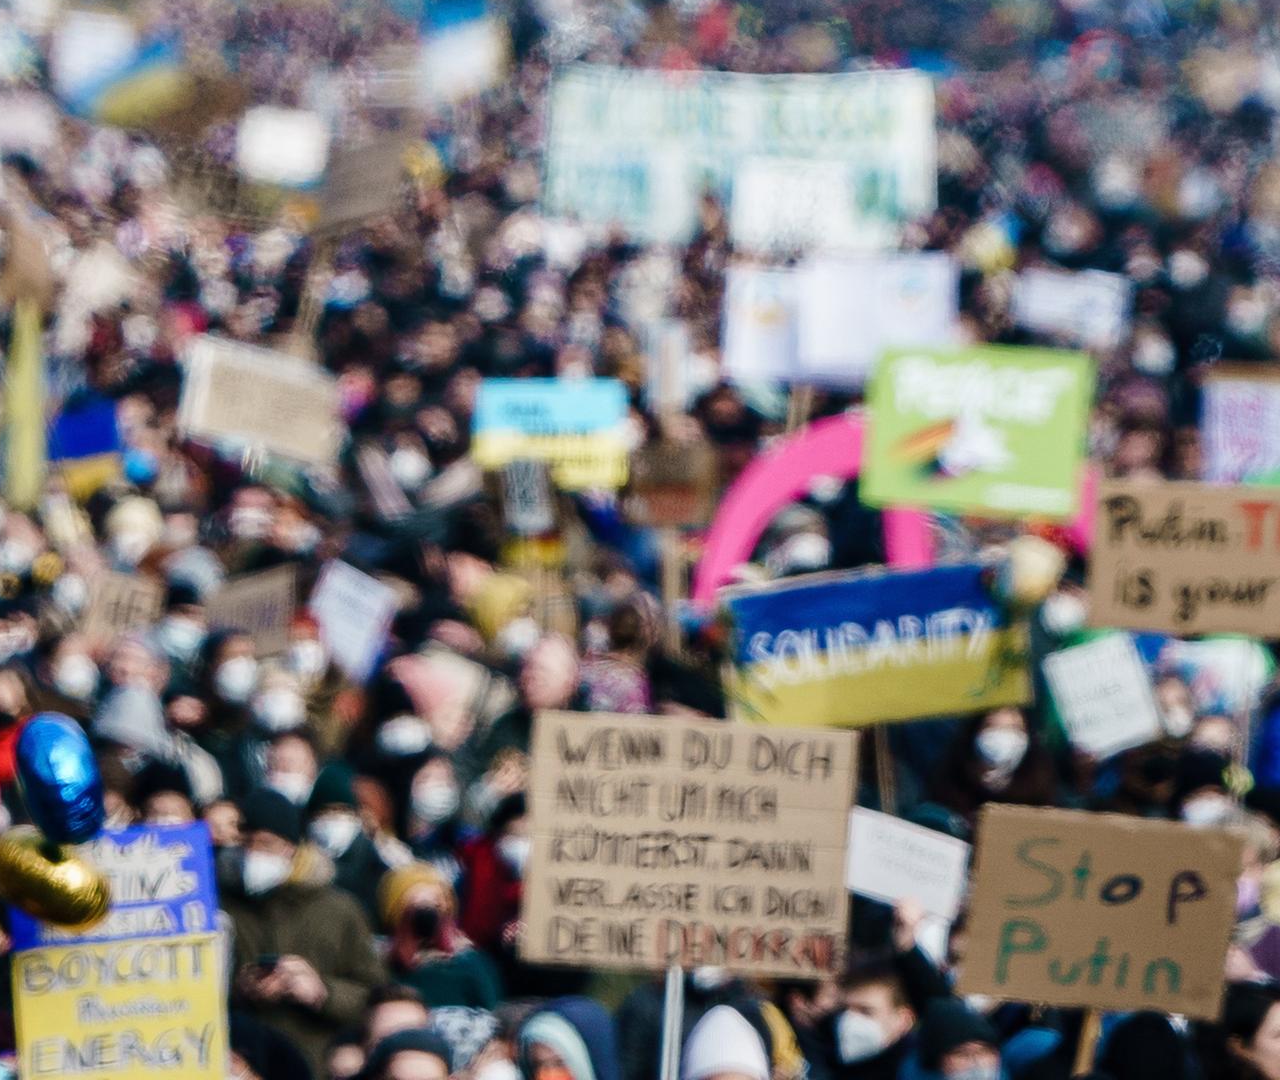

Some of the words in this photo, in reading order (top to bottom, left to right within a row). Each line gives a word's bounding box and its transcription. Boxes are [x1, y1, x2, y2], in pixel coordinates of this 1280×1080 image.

[1103, 493, 1227, 547] Putin
[1173, 576, 1278, 623] your
[746, 606, 994, 690] SOLIDARITY
[556, 724, 666, 770] WENN
[680, 727, 733, 771] DU
[750, 733, 833, 779] DICH
[556, 775, 650, 816] NICHT
[725, 836, 813, 871] DANN
[709, 883, 755, 914] ICH
[1003, 837, 1209, 926] Stop
[547, 916, 648, 957] DEINE
[993, 916, 1183, 995] Putin
[20, 944, 204, 997] BOYCOTT
[31, 1022, 216, 1074] ENERGY
